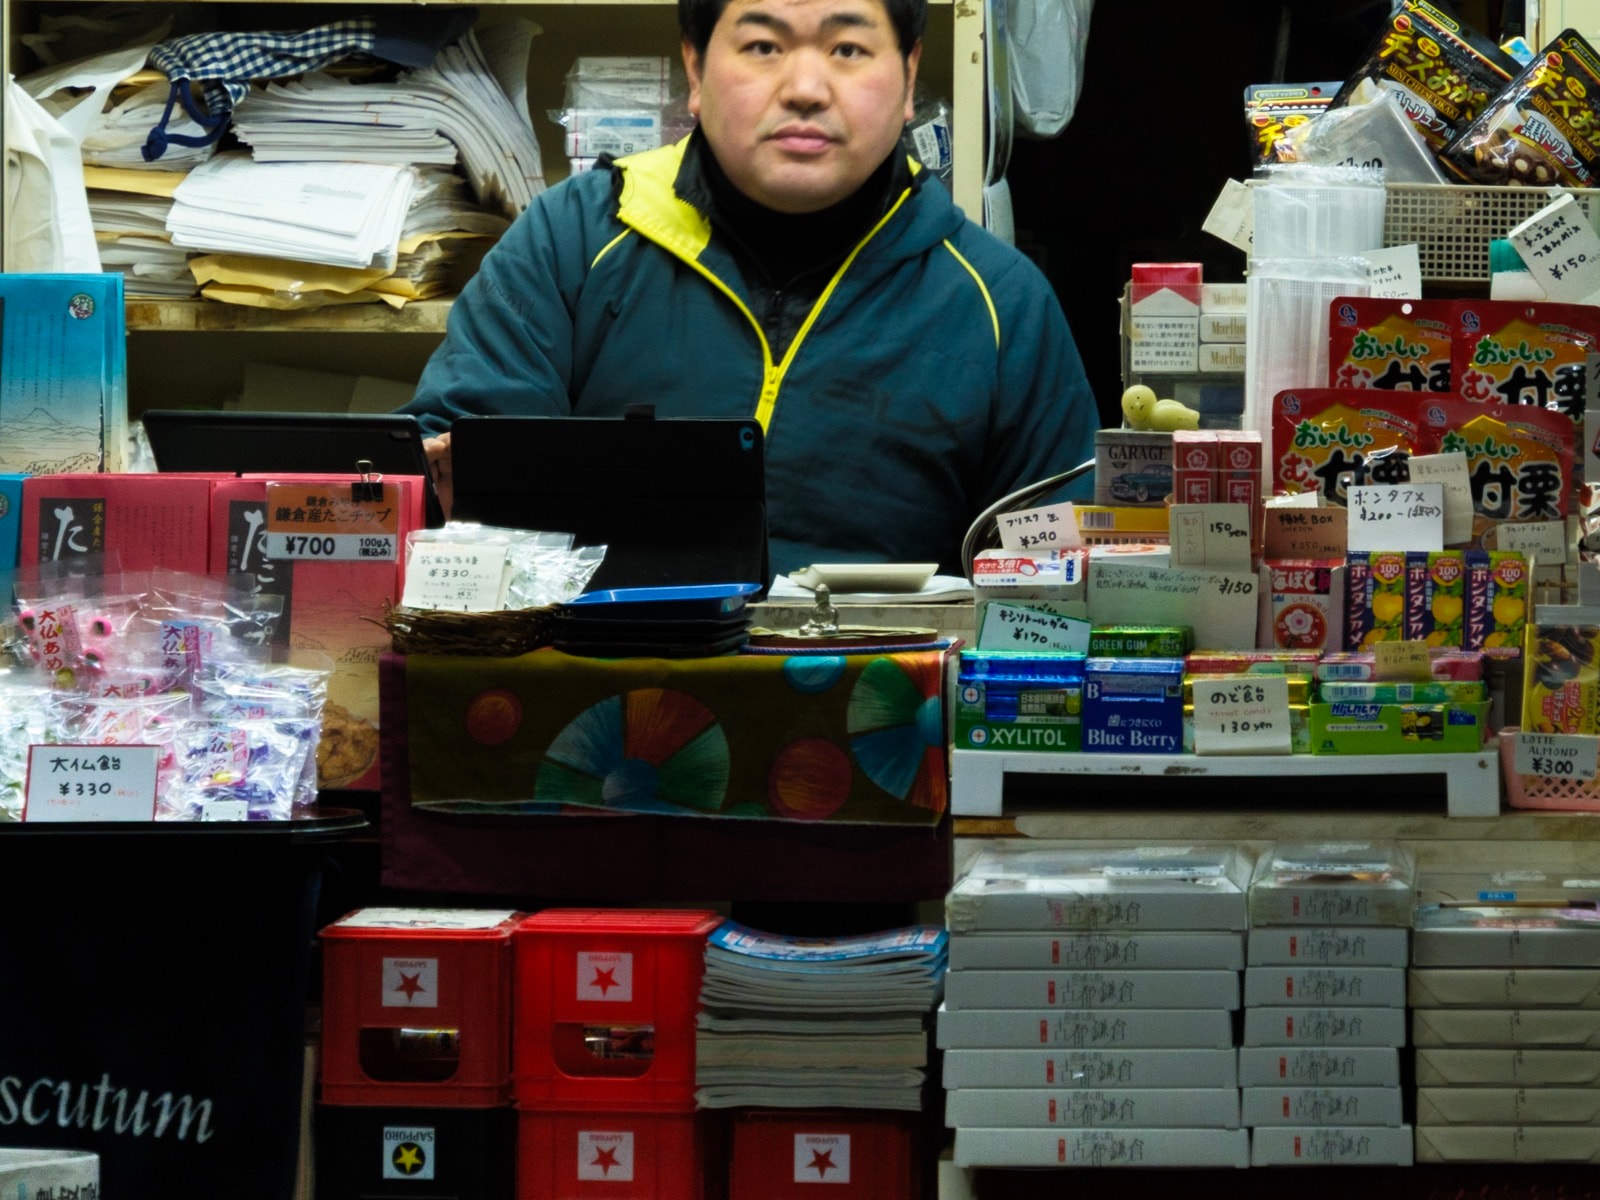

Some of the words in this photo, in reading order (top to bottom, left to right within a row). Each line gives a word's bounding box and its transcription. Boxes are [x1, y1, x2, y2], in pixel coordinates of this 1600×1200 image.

[1549, 253, 1588, 282] ¥150
[1352, 330, 1429, 360] おいしい
[1474, 337, 1556, 366] おいしい
[1294, 419, 1375, 449] おいしい
[1442, 429, 1521, 458] おいしい
[1108, 445, 1167, 461] GARAGE
[1472, 461, 1562, 519] 甘栗
[275, 507, 392, 523] 鎌倉産たこチップ
[286, 536, 336, 556] ¥700
[1019, 531, 1057, 548] ¥290
[429, 568, 469, 577] ¥330
[1380, 564, 1399, 574] 100
[1439, 566, 1458, 576] 100
[1501, 568, 1520, 578] 100
[1219, 577, 1253, 594] ¥150
[1350, 565, 1366, 647] ボンタンアメ
[1469, 567, 1487, 648] ボンタンアメ
[38, 609, 63, 670] 大仏あめ
[1013, 628, 1048, 644] ¥170
[1092, 639, 1123, 651] GREEN
[1126, 639, 1148, 651] GUM
[1211, 685, 1264, 704] のど飴
[1108, 714, 1163, 728] 歯につきにくい
[1221, 722, 1250, 733] 130
[1253, 721, 1273, 731] yen
[992, 728, 1067, 746] XYLITOL
[1088, 728, 1125, 746] Blue
[1130, 730, 1178, 750] Berry
[1522, 735, 1556, 745] LOTTE
[1529, 746, 1578, 758] ALMOND
[50, 755, 121, 772] 大仏飴
[1532, 757, 1574, 775] ¥300
[59, 781, 112, 797] ¥330
[384, 1129, 435, 1141] SAPPORO
